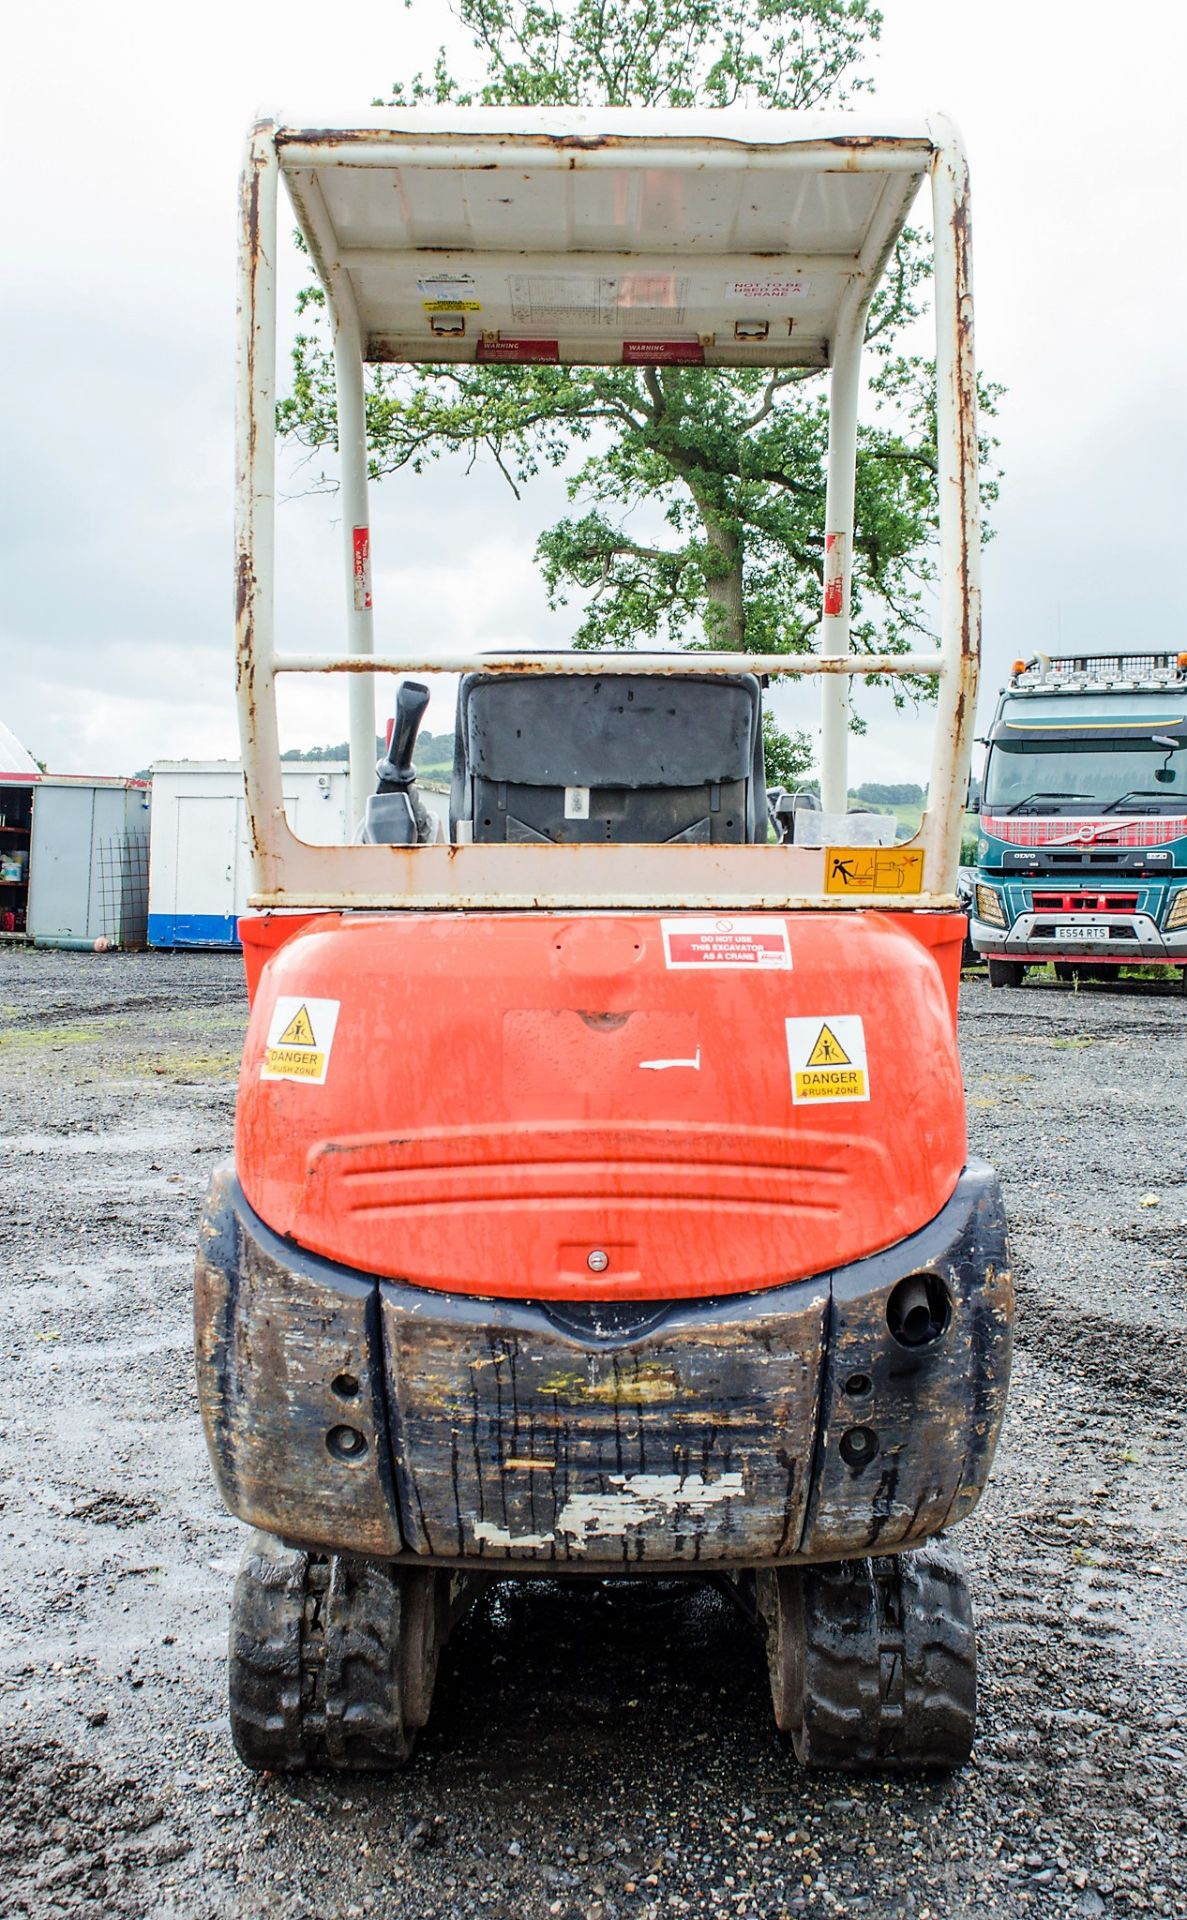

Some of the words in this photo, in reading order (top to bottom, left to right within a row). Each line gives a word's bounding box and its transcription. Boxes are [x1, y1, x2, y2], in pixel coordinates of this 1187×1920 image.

[1060, 929, 1084, 938] ES54
[1086, 929, 1106, 938] RTS
[271, 1051, 318, 1064] DANGER
[294, 1068, 316, 1076] ZONE
[802, 1072, 857, 1084] DANGER
[836, 1086, 858, 1095] ZONE
